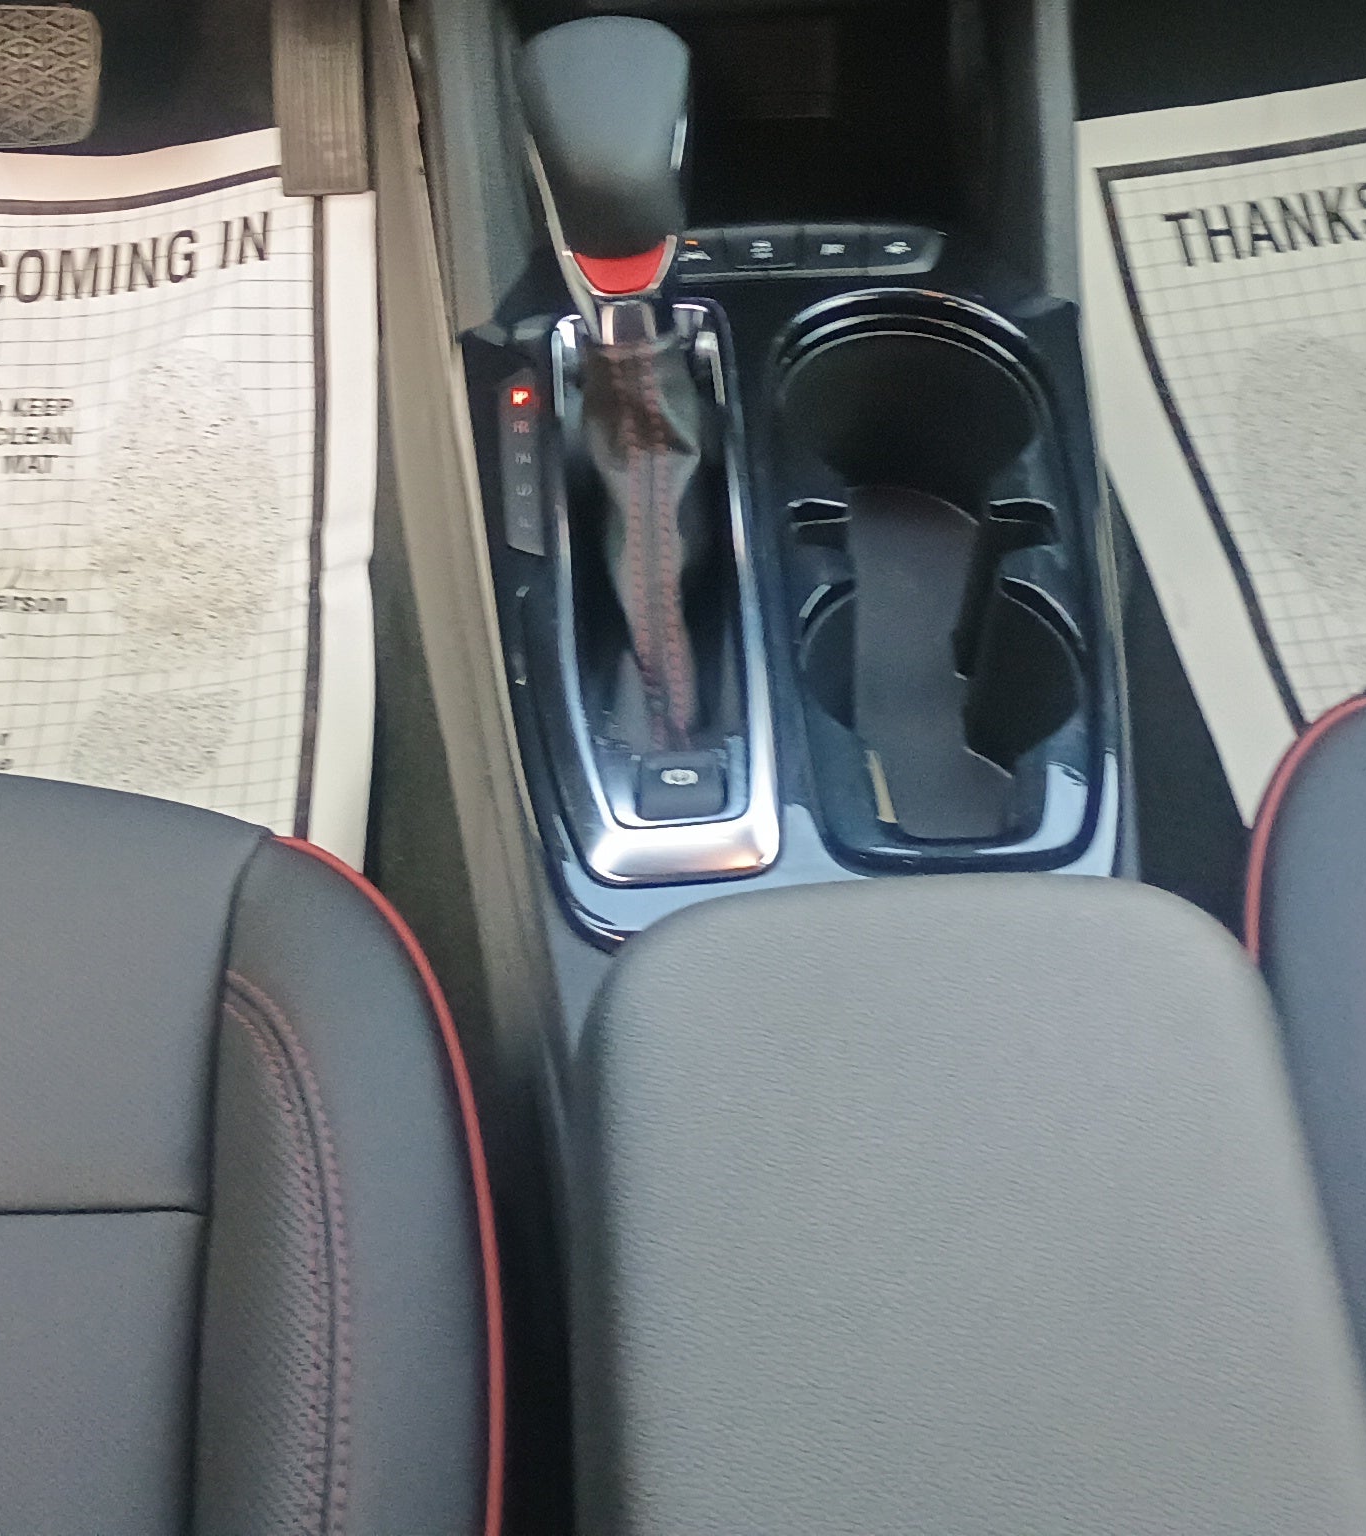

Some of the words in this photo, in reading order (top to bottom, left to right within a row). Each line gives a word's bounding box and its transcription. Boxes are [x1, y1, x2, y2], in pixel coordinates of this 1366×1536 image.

[219, 211, 270, 269] IN
[9, 397, 73, 417] KEEP
[3, 454, 59, 474] MAT
